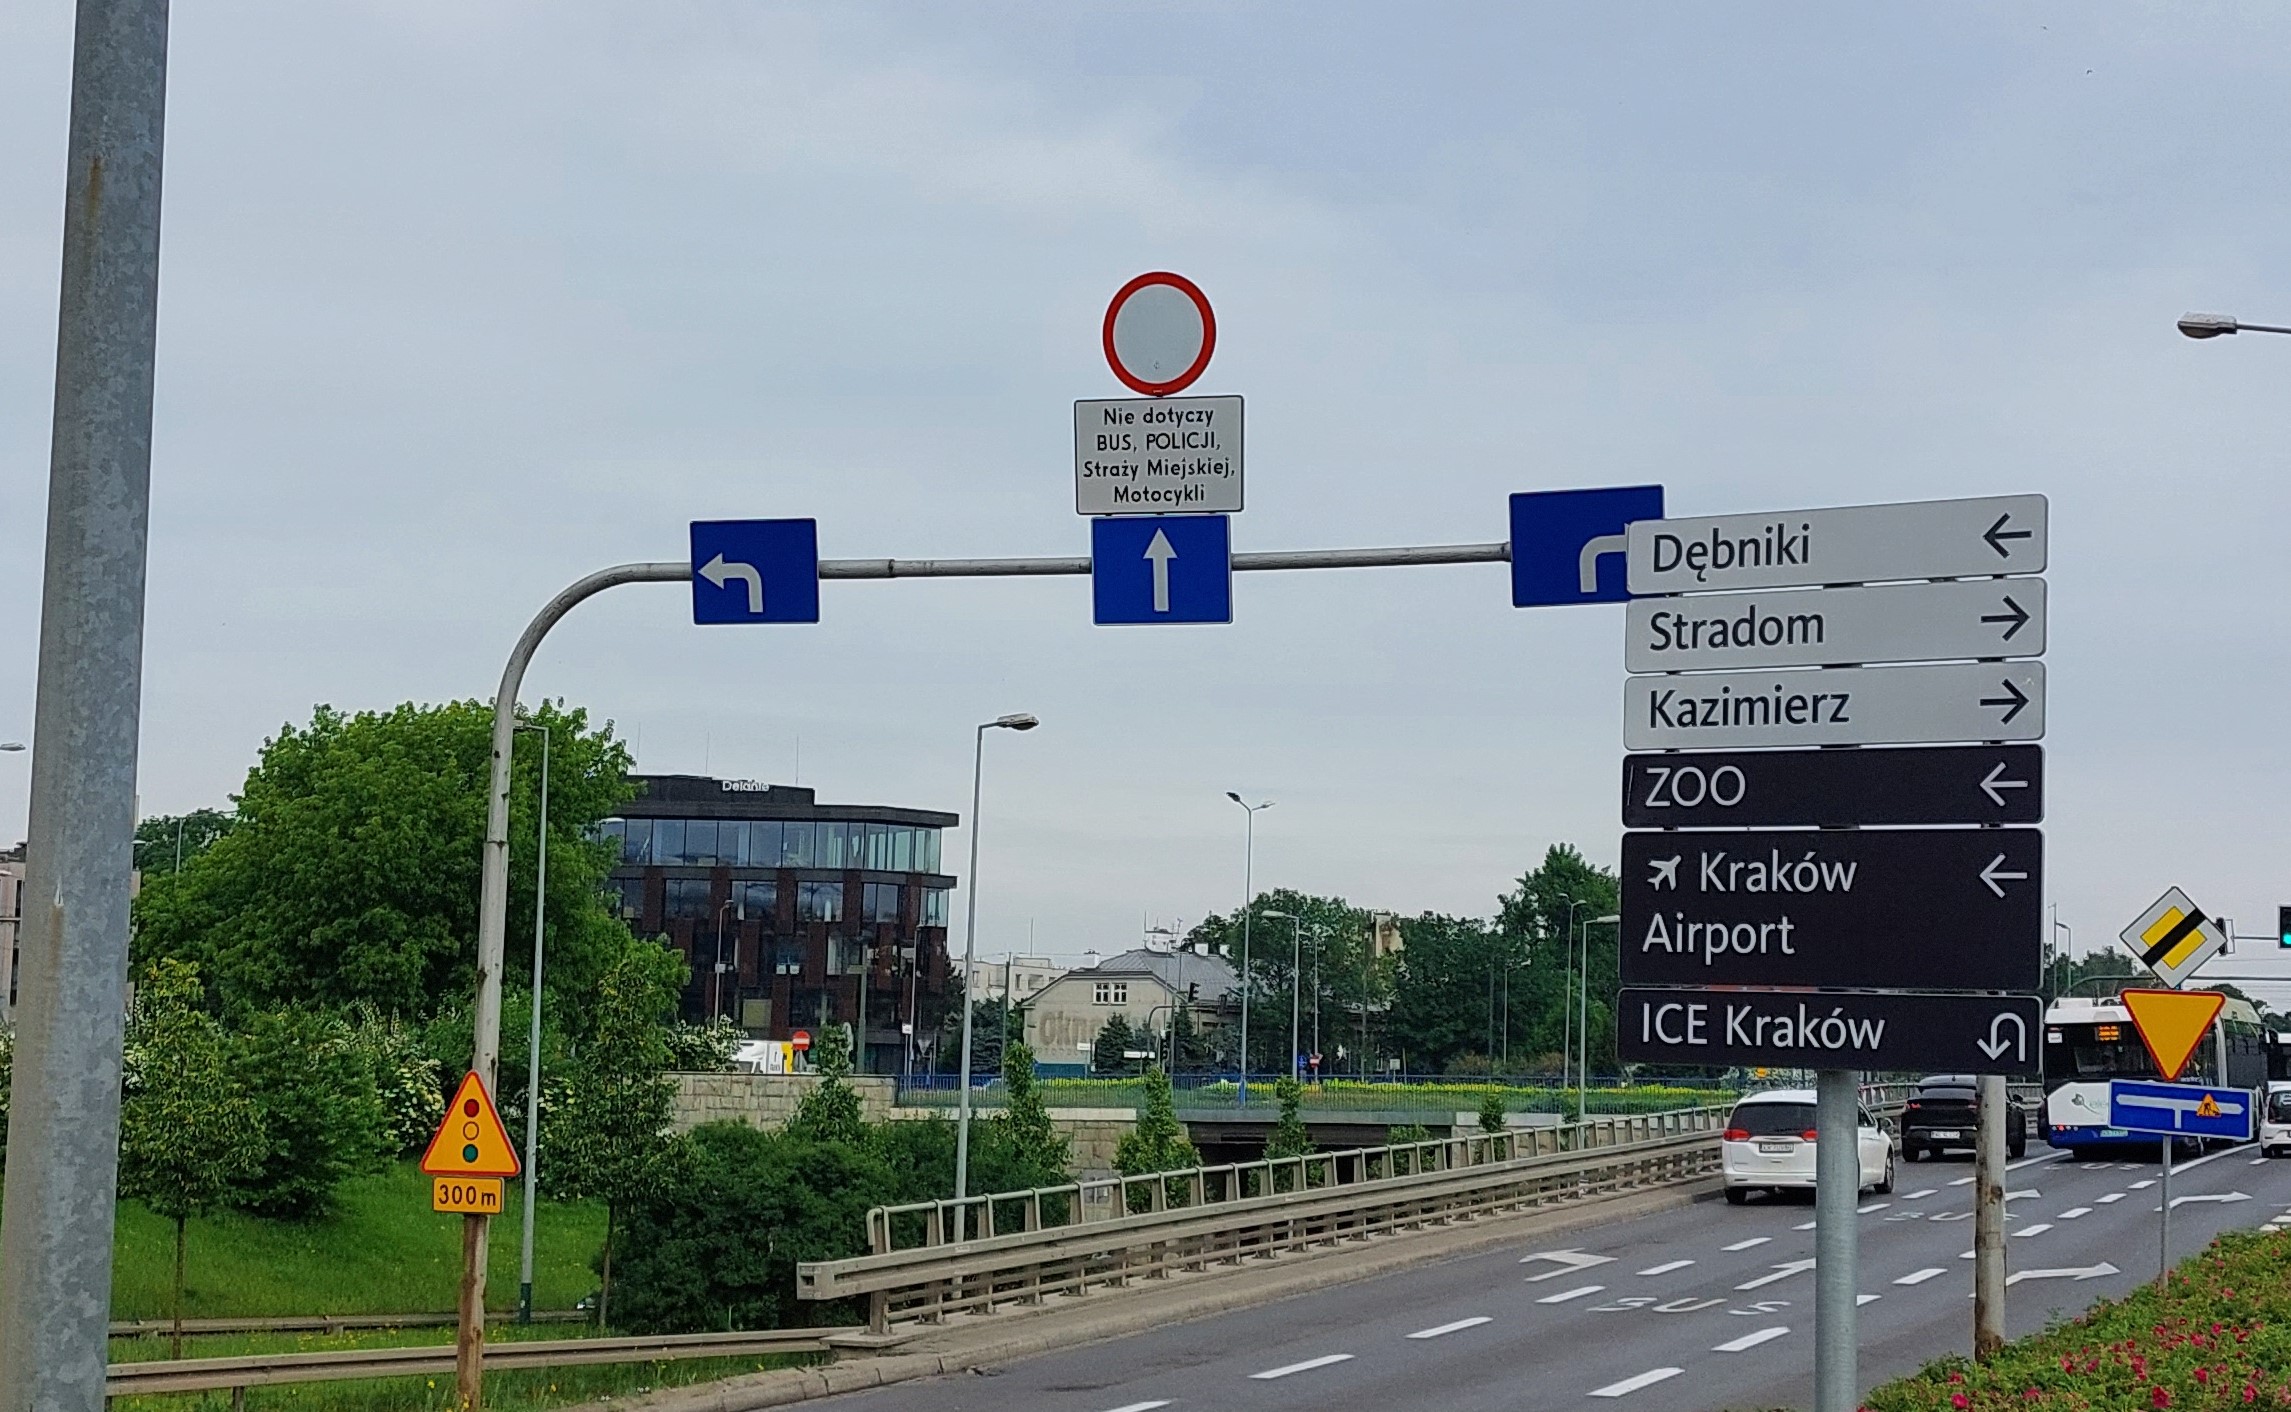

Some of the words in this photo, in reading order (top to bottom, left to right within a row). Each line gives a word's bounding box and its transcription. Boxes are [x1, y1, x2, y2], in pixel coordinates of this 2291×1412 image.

[1104, 407, 1136, 425] Nie
[1143, 407, 1214, 428] dotyczy
[1098, 434, 1137, 453] BUS,
[1147, 432, 1221, 451] POLICJI,
[1084, 460, 1139, 480] Straży
[1148, 457, 1235, 480] Miejskiej,
[1114, 484, 1205, 506] Motocykli
[1654, 524, 1811, 582] Dębniki
[1649, 604, 1824, 651] Stradom
[1650, 683, 1850, 729] Kazimierz
[1645, 765, 1746, 807] ZOO
[1700, 848, 1858, 893] Kraków
[1642, 911, 1795, 966] Airport
[1642, 1002, 1708, 1045] ICE
[1726, 1003, 1886, 1050] Kraków
